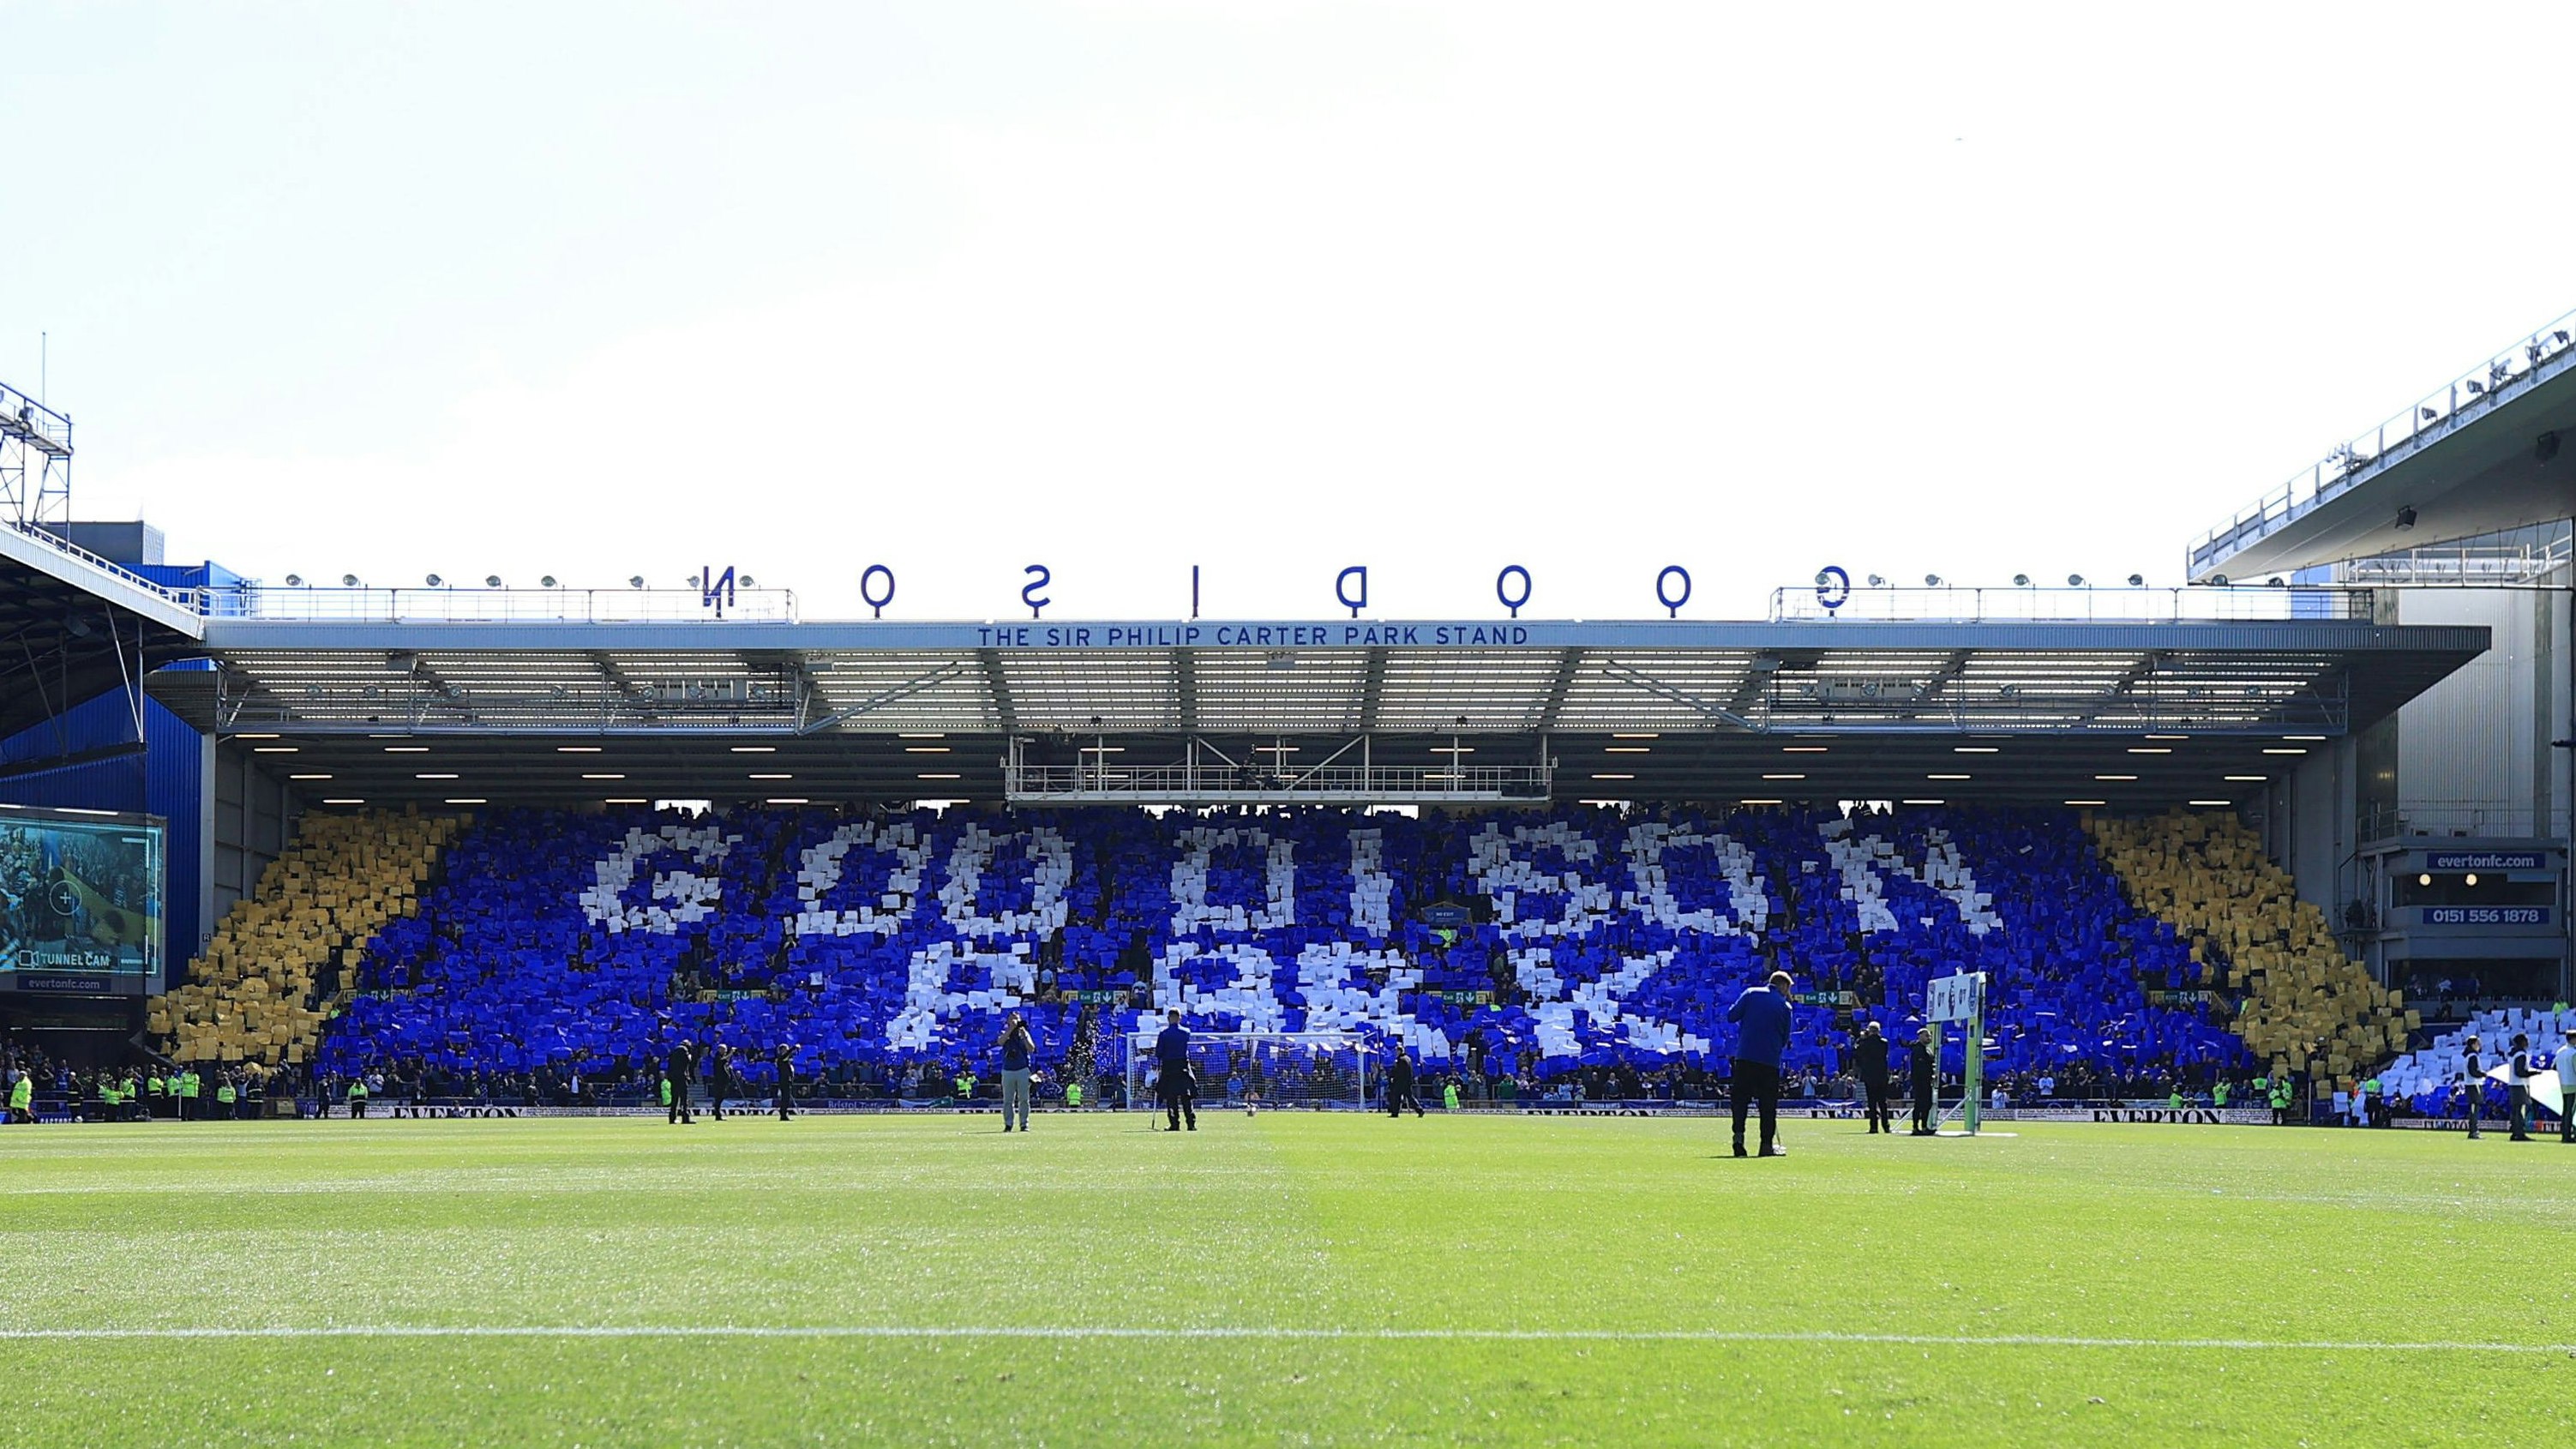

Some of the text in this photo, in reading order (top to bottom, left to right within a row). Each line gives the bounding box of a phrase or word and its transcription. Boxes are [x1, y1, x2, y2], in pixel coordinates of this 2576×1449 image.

[978, 627, 1528, 646] THE SIR PHILIP CARTER PARK STAND
[2437, 854, 2535, 868] evertonfc.com
[579, 819, 2004, 940] GOODISON
[2433, 909, 2539, 923] 0151 556 1878
[41, 953, 111, 967] TUNNEL CAM
[28, 977, 100, 989] evertonfc.com
[828, 1100, 856, 1109] Bristol
[2094, 1109, 2223, 1123] EVERTON
